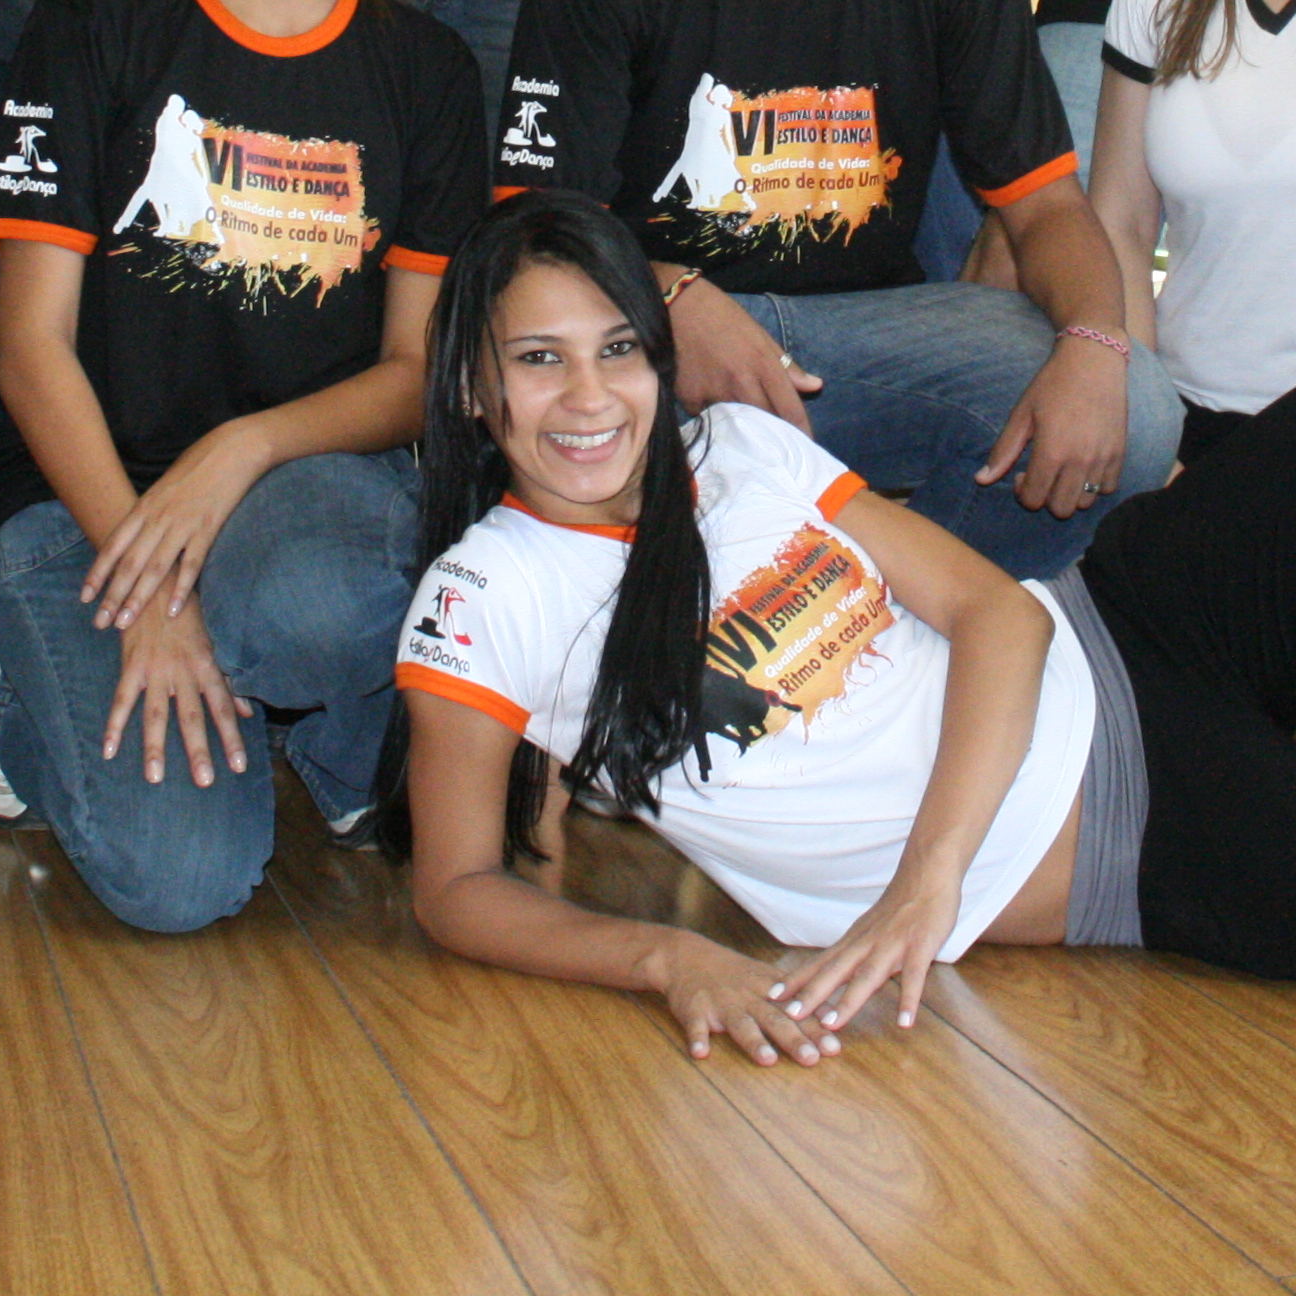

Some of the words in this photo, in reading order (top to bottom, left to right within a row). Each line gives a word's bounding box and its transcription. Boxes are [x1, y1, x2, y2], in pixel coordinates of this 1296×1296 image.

[4, 99, 54, 119] Academia
[778, 110, 811, 123] FESTIVAL
[816, 110, 826, 120] DA
[829, 109, 871, 121] ACADEMIA
[731, 109, 776, 156] VI
[777, 128, 816, 144] ESTILO
[821, 128, 828, 143] E
[832, 127, 872, 148] DANÇA
[202, 137, 243, 191] VI
[247, 153, 282, 168] FESTIVAL
[286, 159, 298, 170] DA
[300, 161, 347, 173] ACADEMIA
[751, 158, 815, 174] Qualidade
[818, 158, 834, 170] de
[838, 157, 870, 169] Vida:
[246, 171, 288, 192] ESTILO
[292, 178, 300, 192] E
[305, 180, 350, 201] DANÇA
[734, 178, 746, 194] O
[752, 177, 790, 194] Ritmo
[796, 172, 815, 189] de
[820, 173, 853, 190] cada
[859, 171, 880, 187] Um
[206, 206, 217, 223] O
[221, 210, 258, 234] Ritmo
[263, 221, 283, 239] de
[288, 225, 327, 243] cada
[334, 227, 358, 247] Um
[220, 195, 284, 218] Qualidade
[288, 208, 306, 220] de
[310, 209, 347, 223] Vida:
[749, 584, 785, 614] FESTIVAL
[781, 574, 797, 587] DA
[793, 542, 830, 576] ACADEMIA
[765, 594, 809, 633] ESTILO
[803, 584, 818, 600] E
[812, 554, 851, 592] DANÇA
[707, 609, 777, 672] VI
[765, 625, 823, 678] Qualidade
[823, 611, 839, 628] de
[836, 585, 867, 612] Vida:
[778, 658, 821, 696] Ritmo
[818, 641, 841, 662] de
[839, 614, 870, 644] cada
[865, 598, 886, 619] Um
